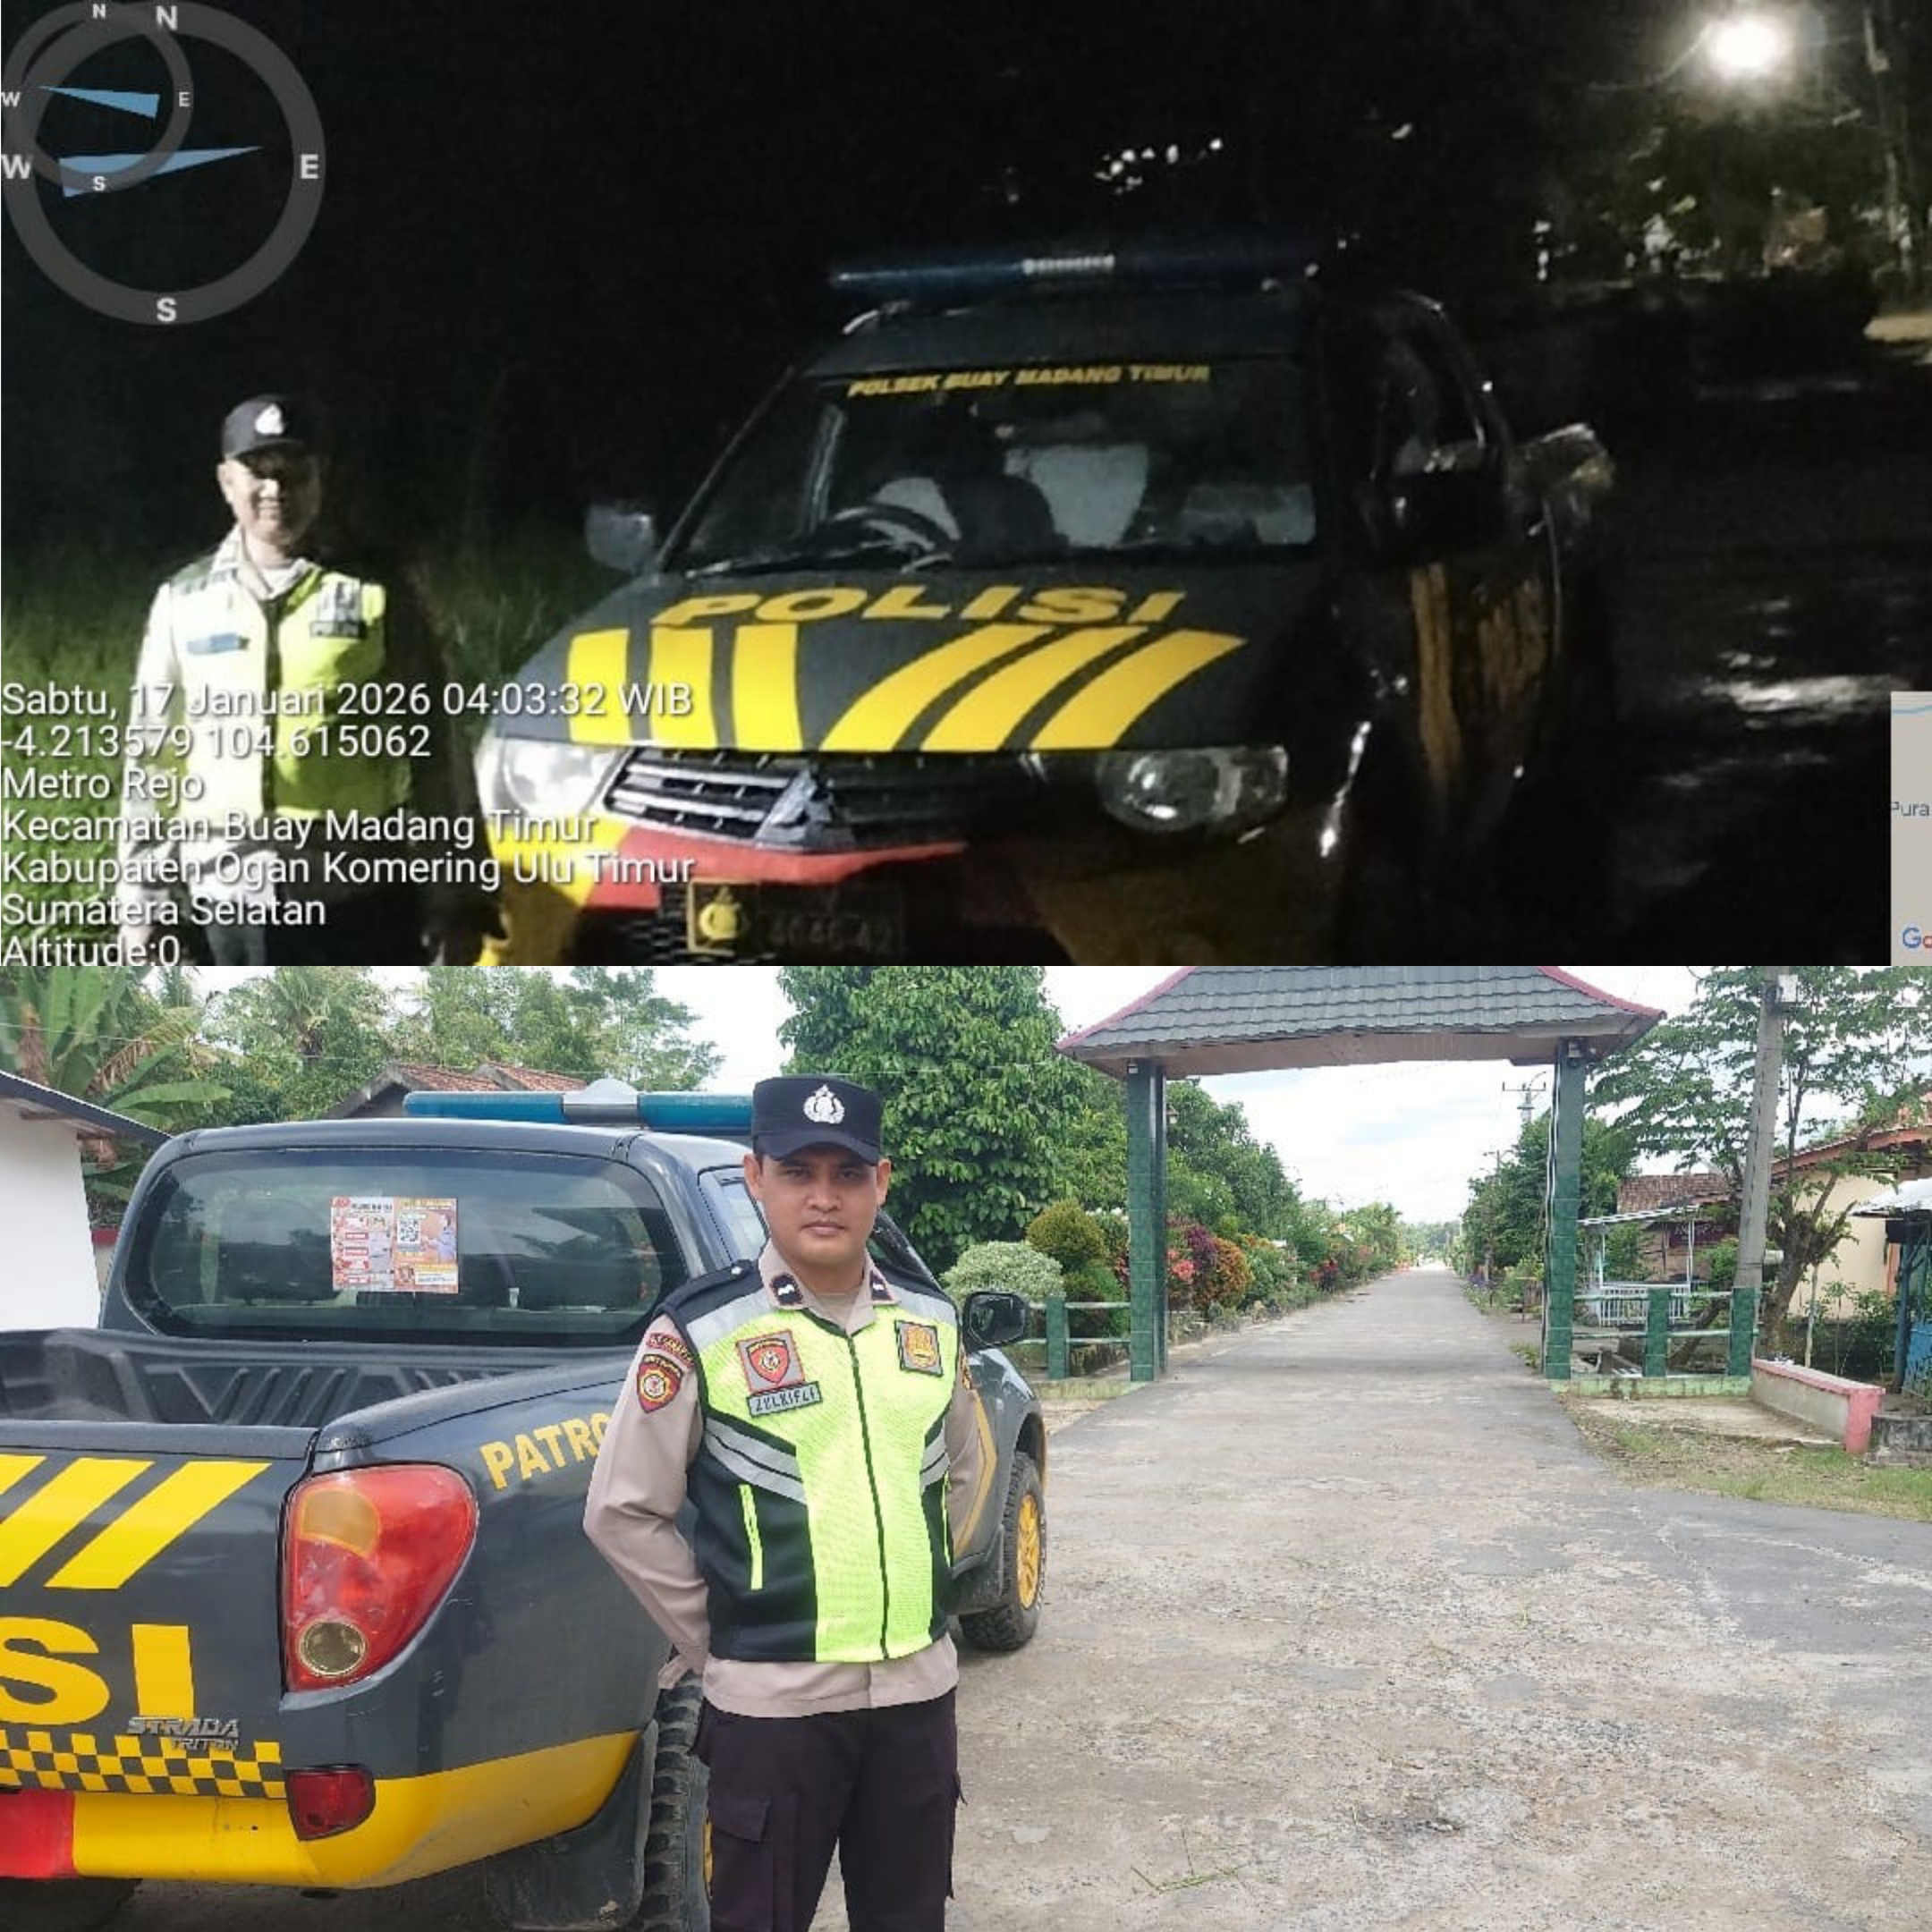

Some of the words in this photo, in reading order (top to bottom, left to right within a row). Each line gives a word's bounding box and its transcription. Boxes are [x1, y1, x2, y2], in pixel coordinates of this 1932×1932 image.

[650, 586, 1186, 624] POLISI
[0, 1616, 195, 1724] SI
[127, 1716, 239, 1737] STRADA
